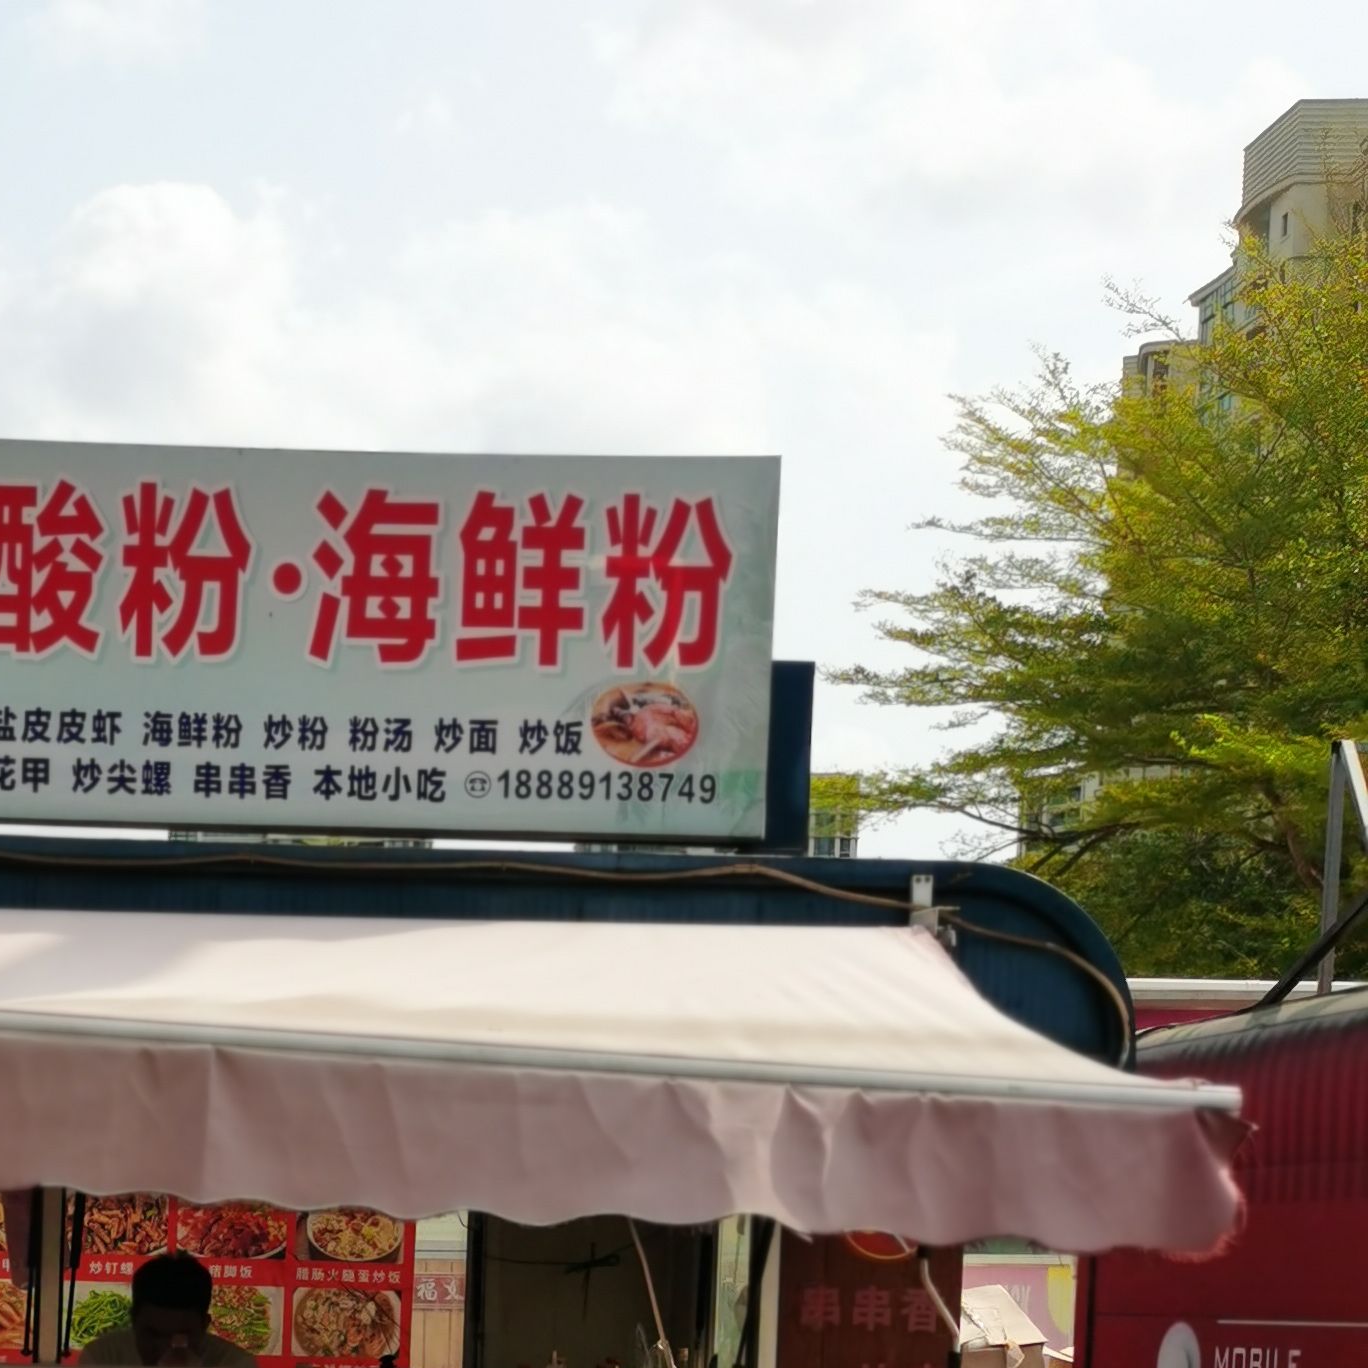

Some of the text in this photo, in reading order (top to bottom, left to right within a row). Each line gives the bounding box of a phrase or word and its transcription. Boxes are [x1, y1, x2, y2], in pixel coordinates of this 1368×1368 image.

[142, 710, 243, 749] 海鲜粉
[263, 714, 329, 752] 炒粉
[349, 716, 413, 753] 粉汤
[434, 717, 499, 755] 炒面
[518, 719, 584, 756] 炒饭
[72, 758, 172, 796] 炒尖螺
[193, 761, 292, 801] 串串香
[313, 764, 447, 803] 本地小吃
[497, 769, 717, 805] 18889138749
[800, 1285, 939, 1332] 串串香
